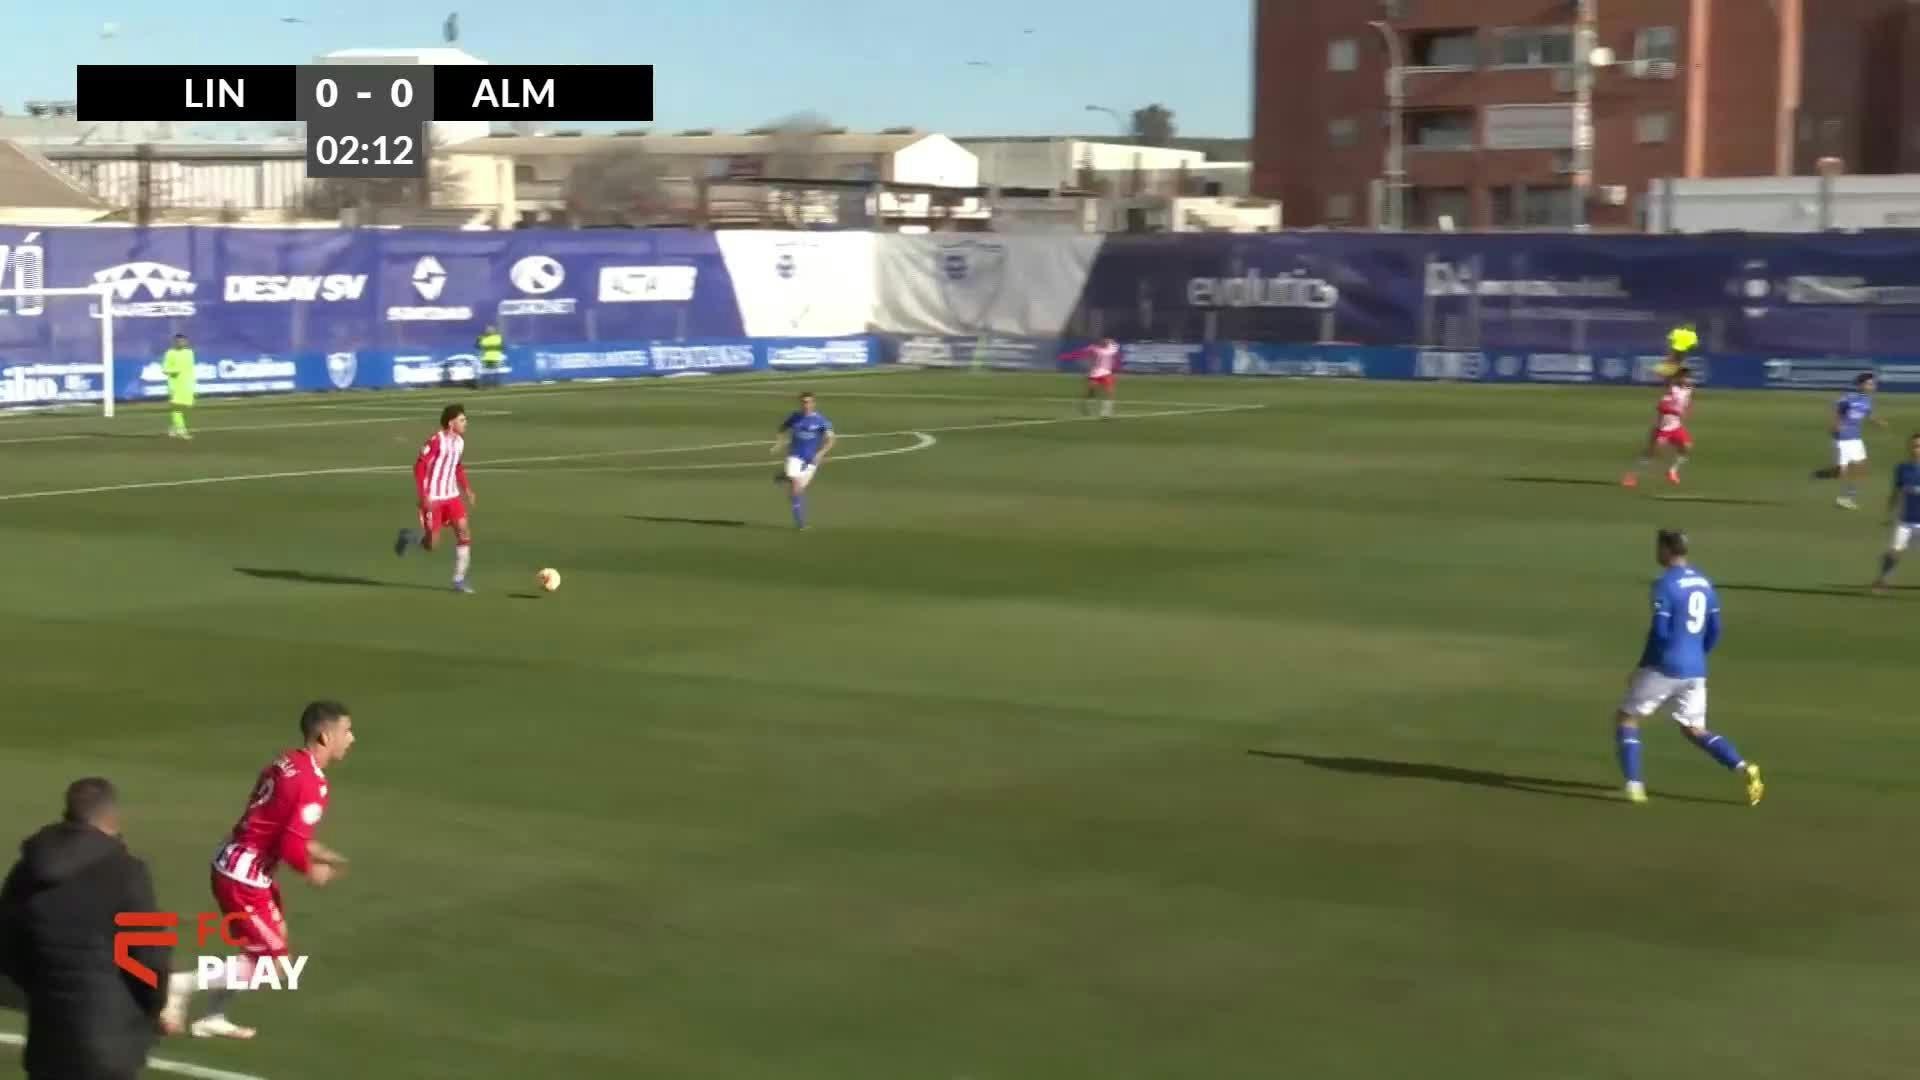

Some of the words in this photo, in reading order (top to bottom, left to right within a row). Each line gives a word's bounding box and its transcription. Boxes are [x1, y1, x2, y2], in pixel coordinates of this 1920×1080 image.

[224, 275, 322, 302] DESAY
[321, 274, 368, 301] SV
[1686, 591, 1707, 634] 9
